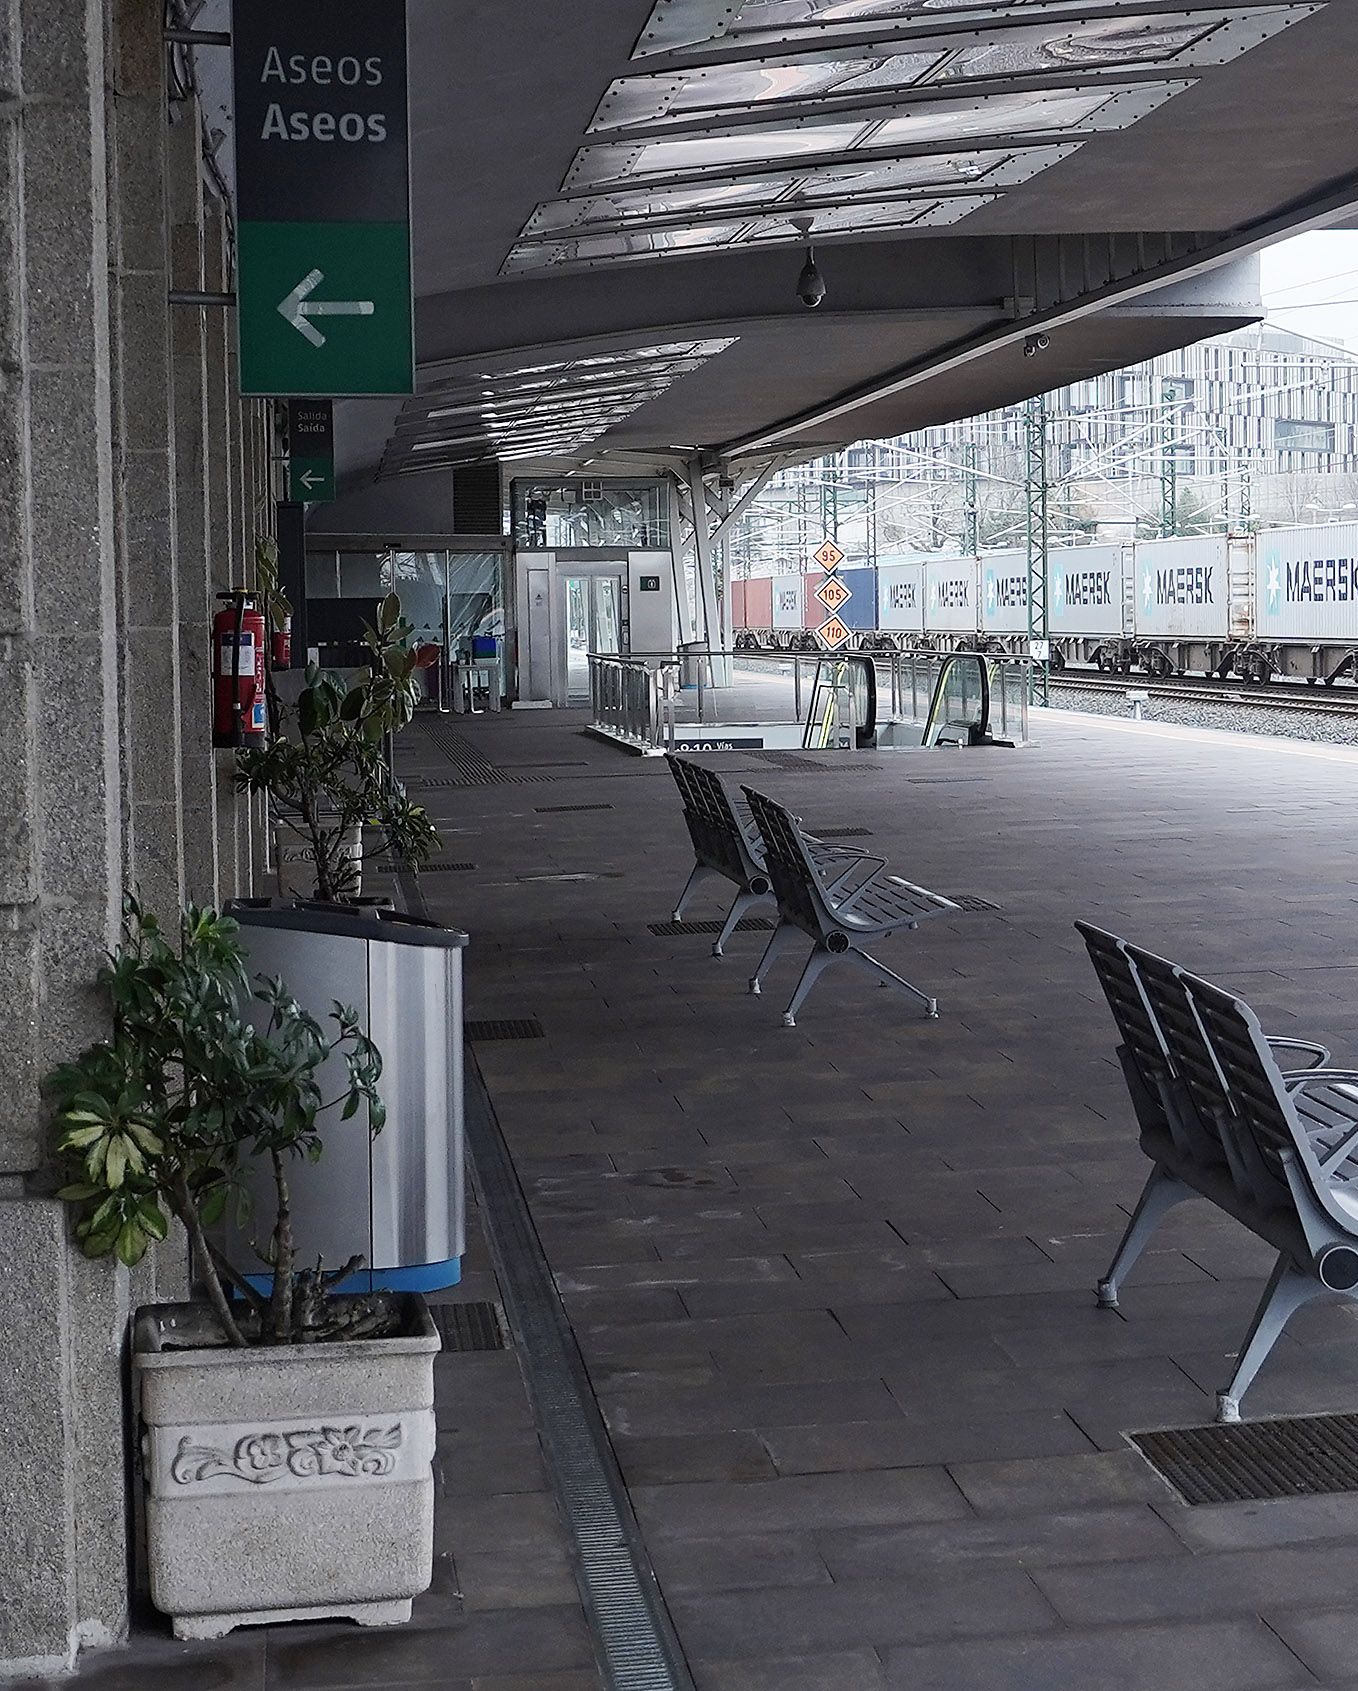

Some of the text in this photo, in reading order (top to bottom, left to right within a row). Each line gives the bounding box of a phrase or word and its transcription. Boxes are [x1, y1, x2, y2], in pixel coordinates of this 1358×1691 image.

[261, 46, 383, 86] Aseos
[261, 103, 387, 142] Aseos
[297, 410, 327, 420] Salida
[297, 422, 325, 432] Saída
[822, 550, 836, 562] 95
[823, 589, 842, 601] 105
[938, 580, 969, 607] MAERSK
[996, 577, 1033, 607] MAERS
[1065, 571, 1111, 605] MAERSK
[1157, 566, 1214, 604] MAERSK
[827, 626, 842, 639] 110
[1034, 641, 1044, 649] 27
